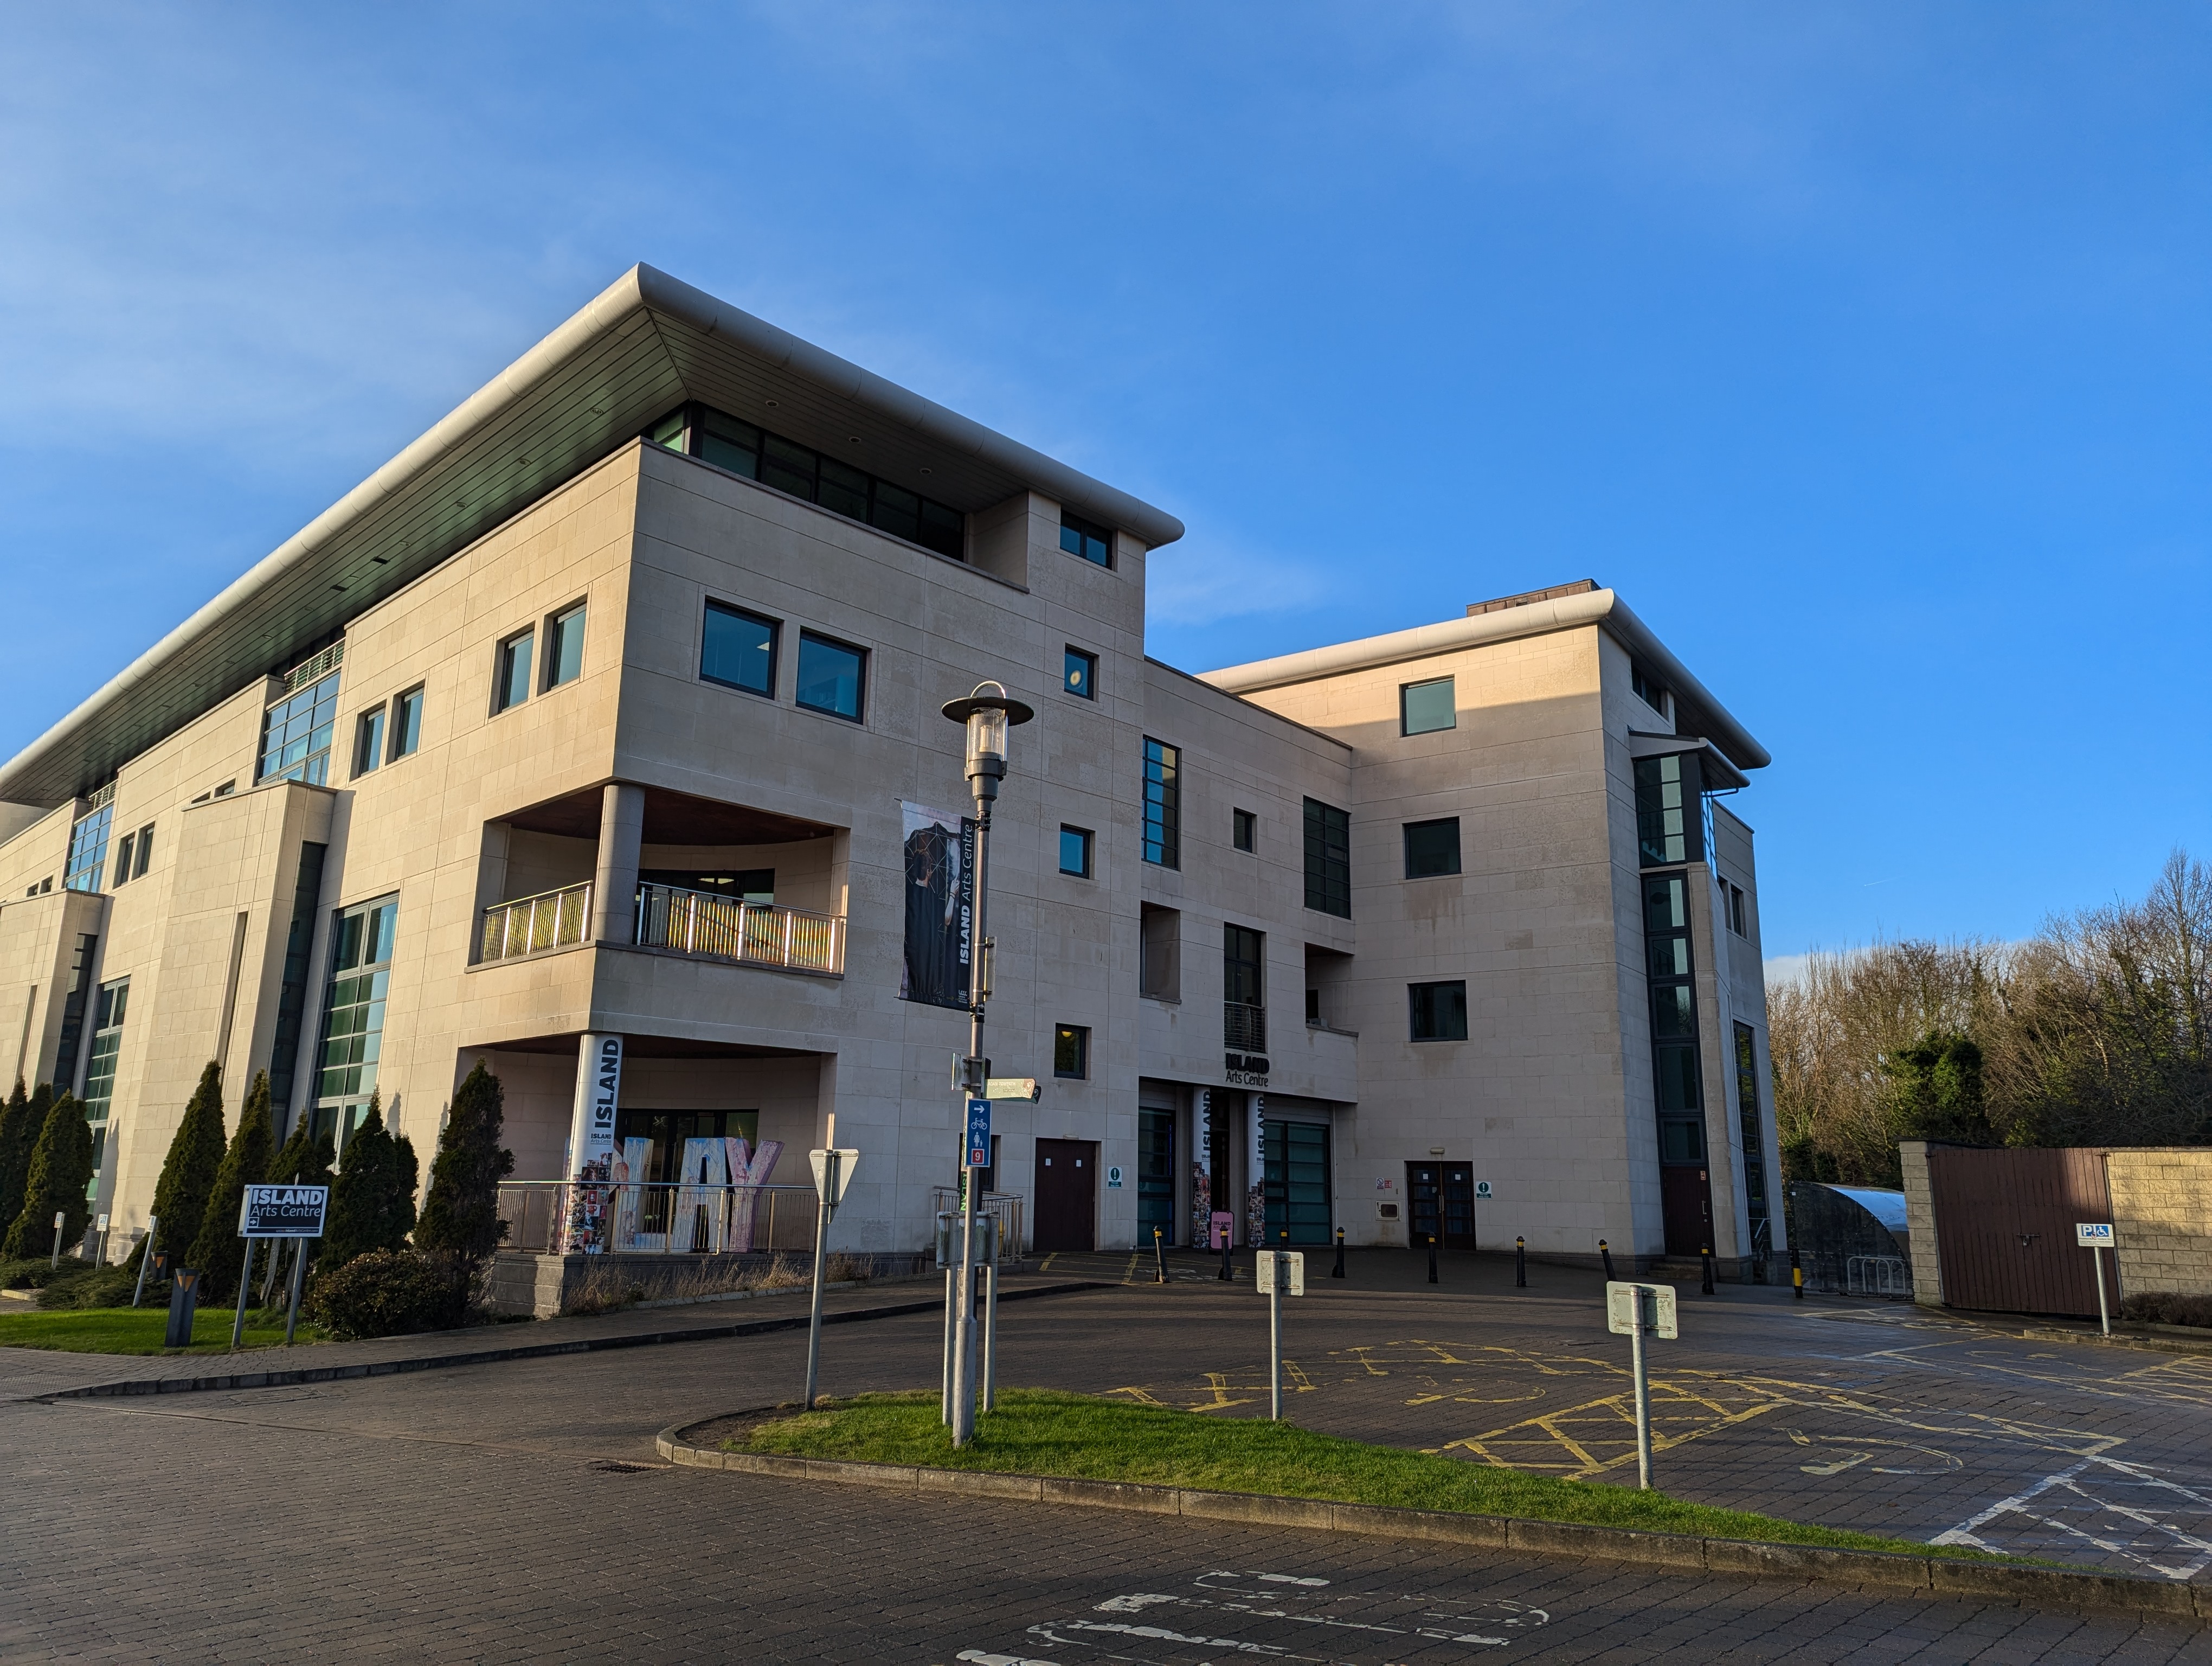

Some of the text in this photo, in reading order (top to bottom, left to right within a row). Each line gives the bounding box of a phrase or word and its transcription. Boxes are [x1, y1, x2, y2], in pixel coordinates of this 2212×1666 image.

[960, 824, 973, 964] ISLAND Arts Centre
[1225, 1053, 1270, 1074] ISLAND
[595, 1040, 619, 1128] ISLAND
[1226, 1071, 1269, 1087] Arts Centre
[975, 1152, 981, 1161] 9
[252, 1189, 323, 1205] ISLAND
[559, 1136, 785, 1254] LAY
[250, 1205, 321, 1217] Arts Centre
[2083, 1226, 2092, 1236] P
